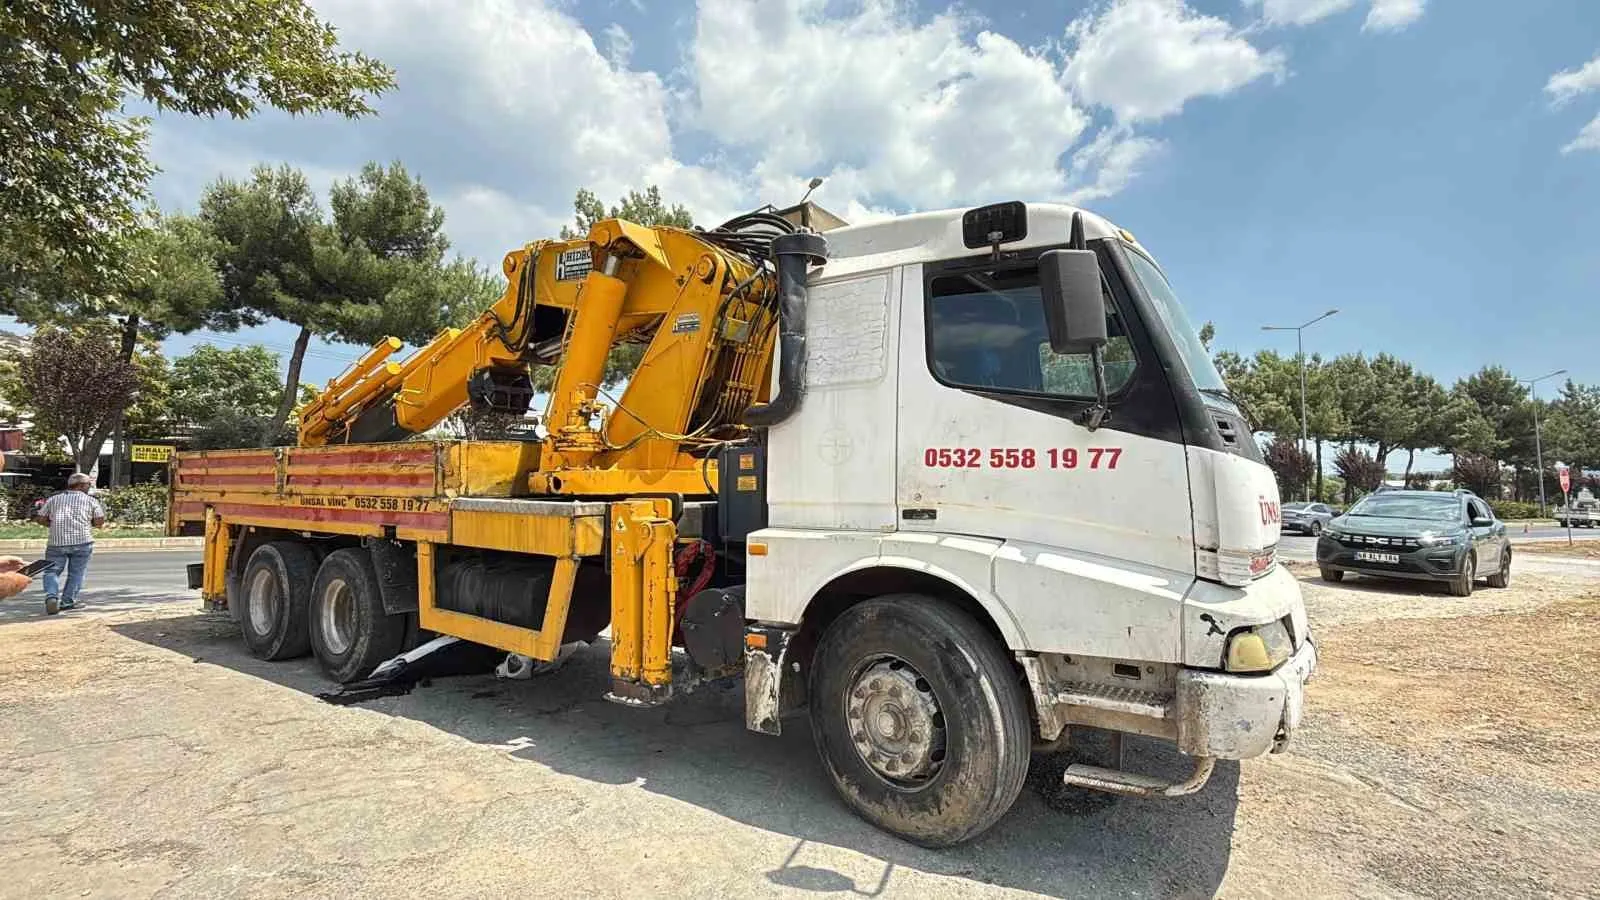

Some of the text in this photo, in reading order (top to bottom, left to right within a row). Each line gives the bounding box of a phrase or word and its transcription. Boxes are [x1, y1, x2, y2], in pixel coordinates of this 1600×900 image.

[924, 448, 1123, 469] 0532 558 19 77
[354, 497, 378, 510] 0532
[379, 498, 399, 511] 558
[402, 499, 414, 512] 19
